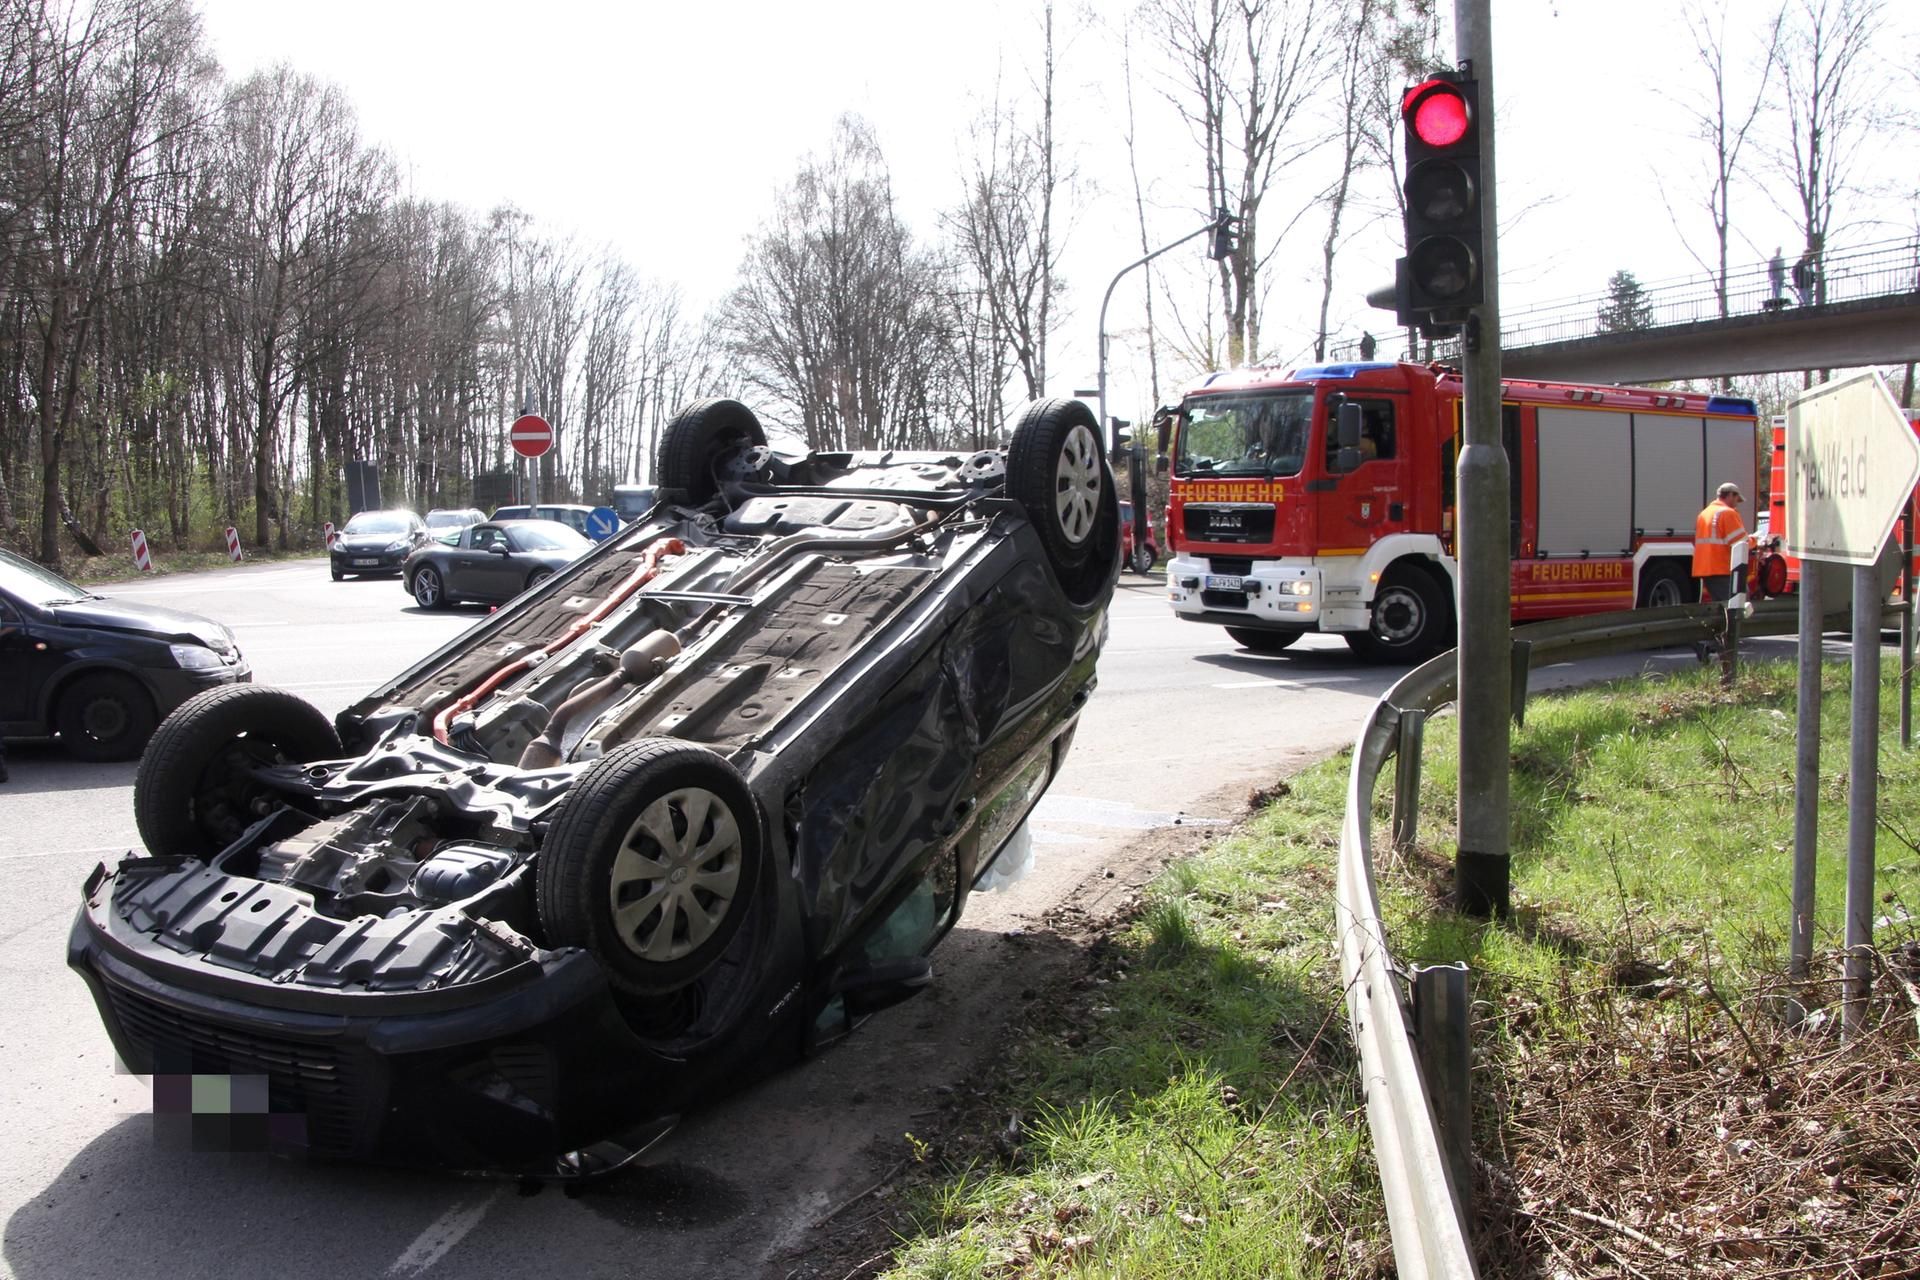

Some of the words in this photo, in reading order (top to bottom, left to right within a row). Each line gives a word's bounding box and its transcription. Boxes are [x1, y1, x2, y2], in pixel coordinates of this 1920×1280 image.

[1794, 437, 1868, 502] FriedWald
[1177, 484, 1283, 502] FEUERWEHR
[1210, 516, 1242, 527] MAN
[1532, 563, 1623, 582] FEUERWEHR
